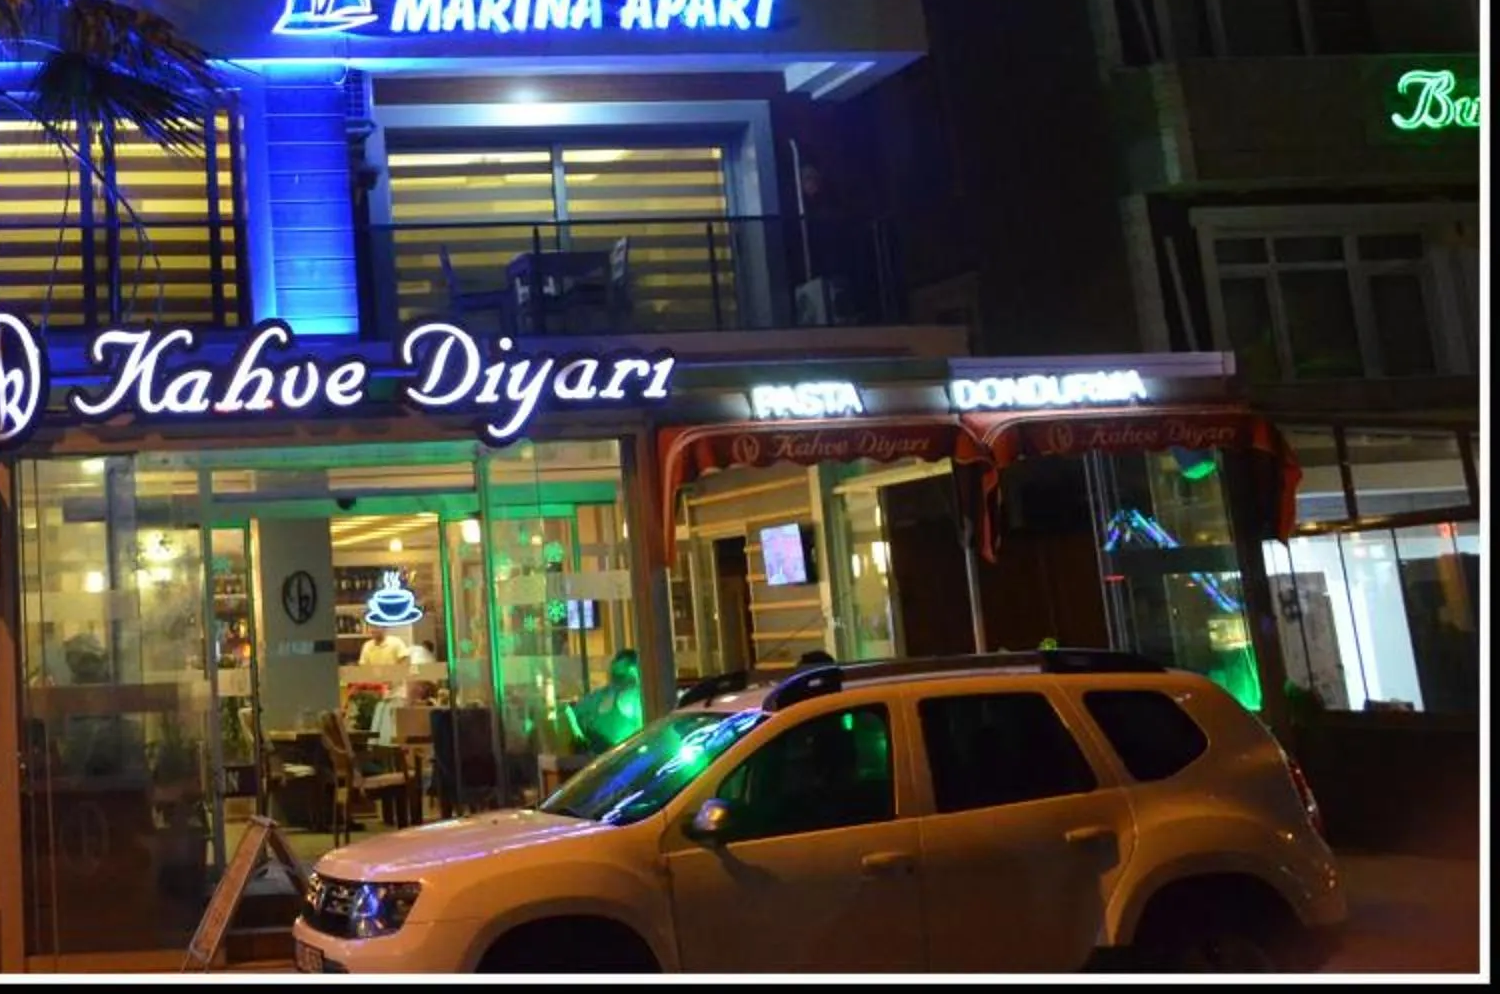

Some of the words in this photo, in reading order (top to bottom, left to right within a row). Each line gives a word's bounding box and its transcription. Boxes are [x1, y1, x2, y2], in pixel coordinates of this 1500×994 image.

[73, 325, 366, 415] Kahve
[403, 323, 675, 438] Diyarı
[952, 370, 1148, 409] DONDURMA
[752, 381, 864, 420] PASTA
